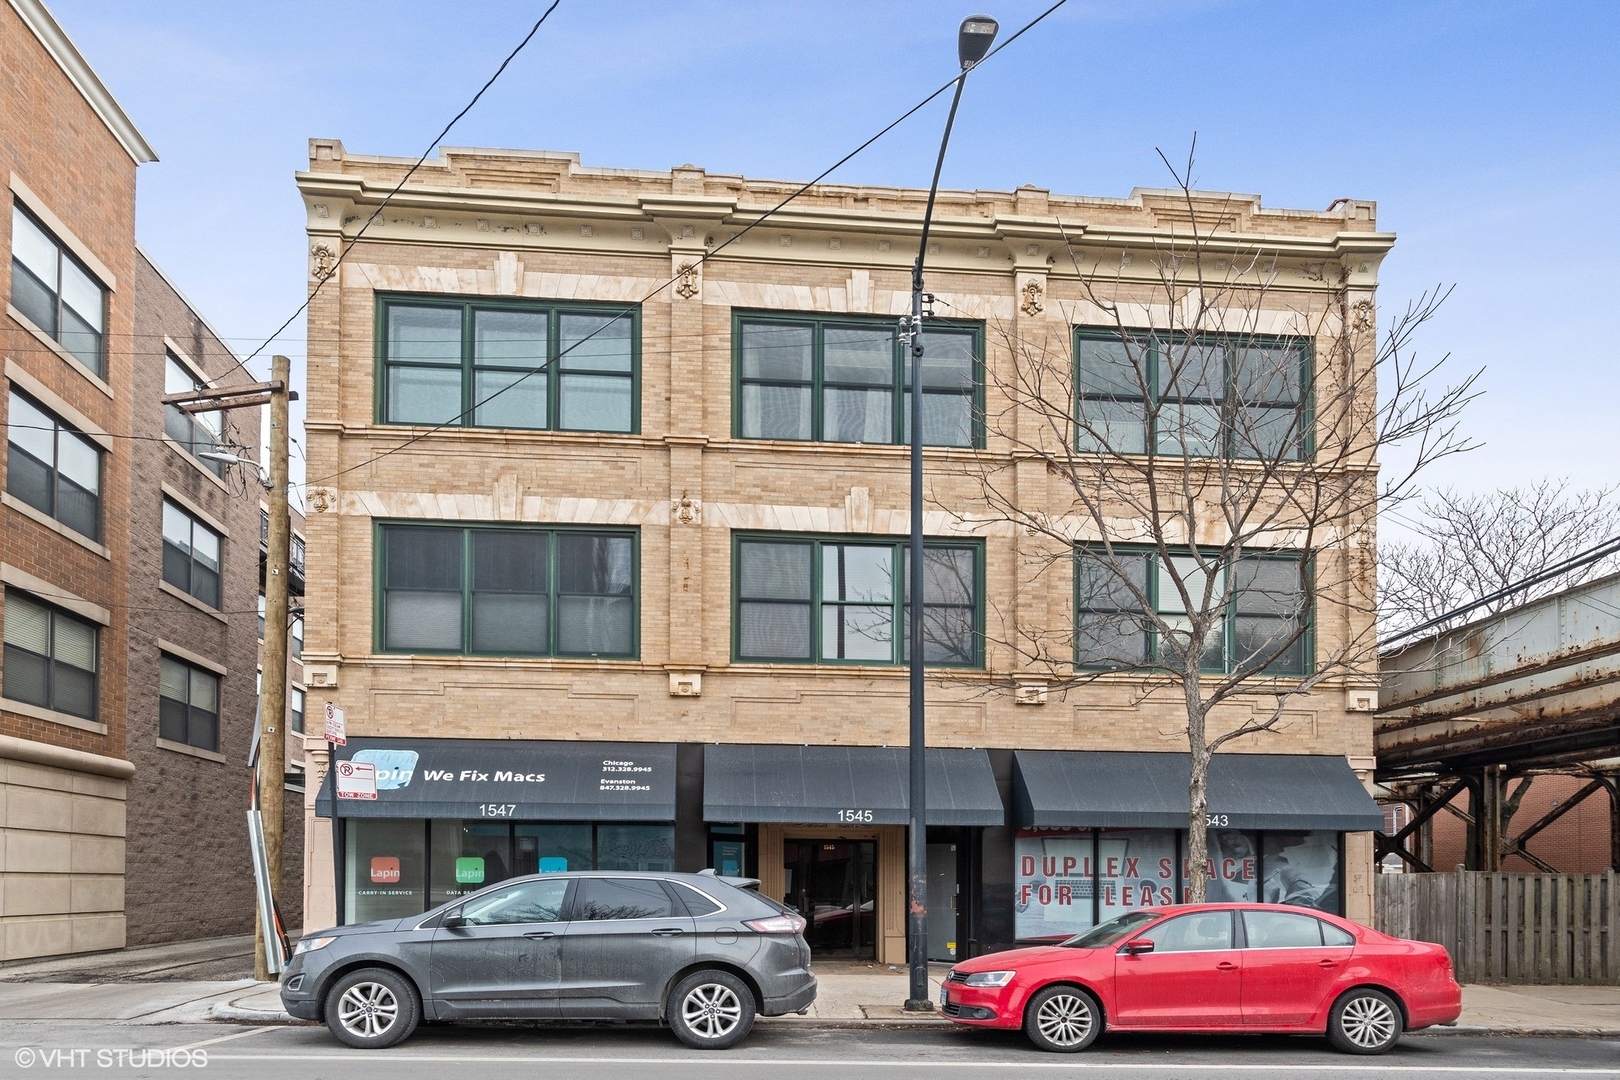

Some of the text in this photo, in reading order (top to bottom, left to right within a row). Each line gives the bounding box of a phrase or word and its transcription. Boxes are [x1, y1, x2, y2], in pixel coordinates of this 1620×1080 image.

[375, 767, 413, 782] pin
[423, 769, 546, 783] We Fix Macs
[479, 804, 516, 817] 1547
[837, 809, 873, 822] 1545
[1205, 814, 1229, 827] 543
[1021, 855, 1141, 878] DUPLEX
[370, 868, 400, 879] Lapin
[455, 868, 485, 879] Lapin
[1020, 884, 1073, 906] FOR
